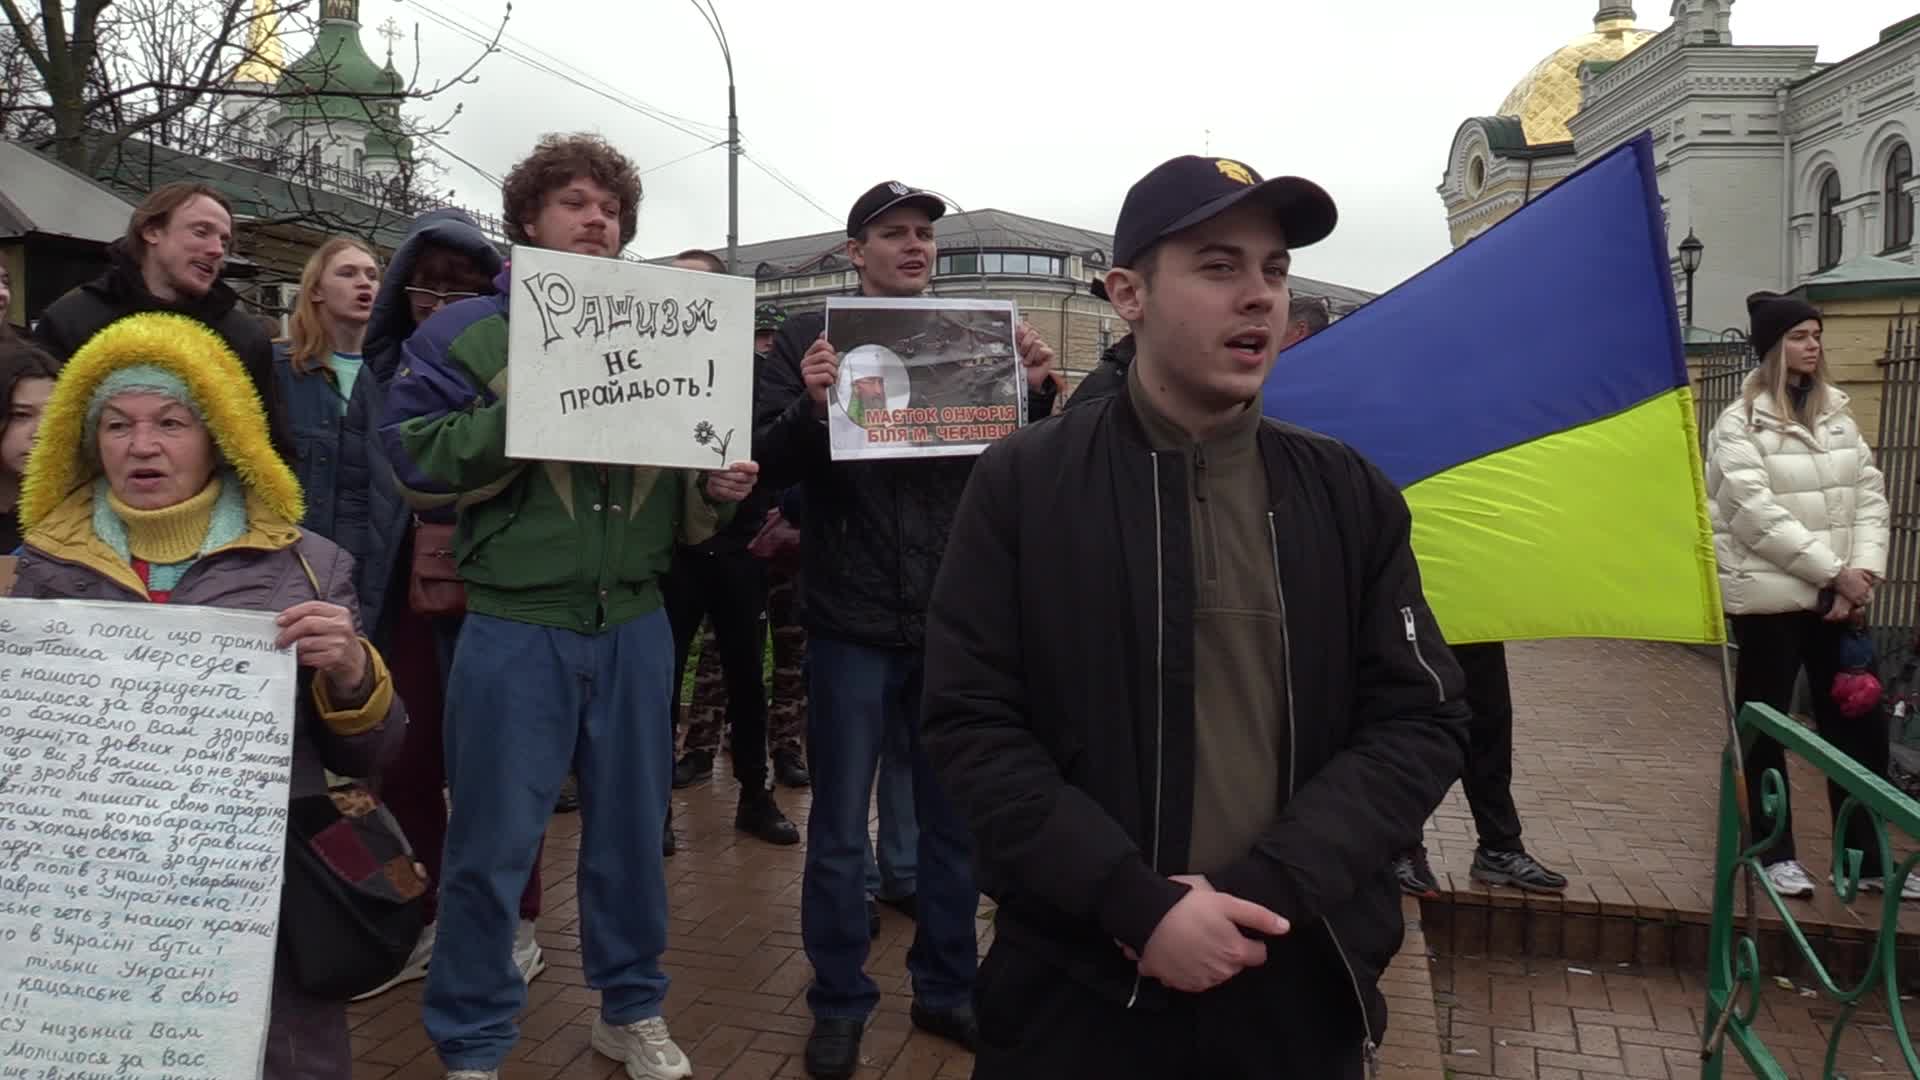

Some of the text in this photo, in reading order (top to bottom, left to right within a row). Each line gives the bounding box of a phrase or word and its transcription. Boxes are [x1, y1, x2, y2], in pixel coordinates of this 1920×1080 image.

[866, 405, 1017, 425] МАЄТОК ОНУФРІЯ
[867, 427, 907, 443] БІЛЯ
[42, 619, 75, 635] за
[168, 631, 201, 646] що
[21, 669, 101, 689] нашого
[32, 765, 102, 783] зробив
[173, 763, 204, 777] що
[0, 873, 51, 900] аври
